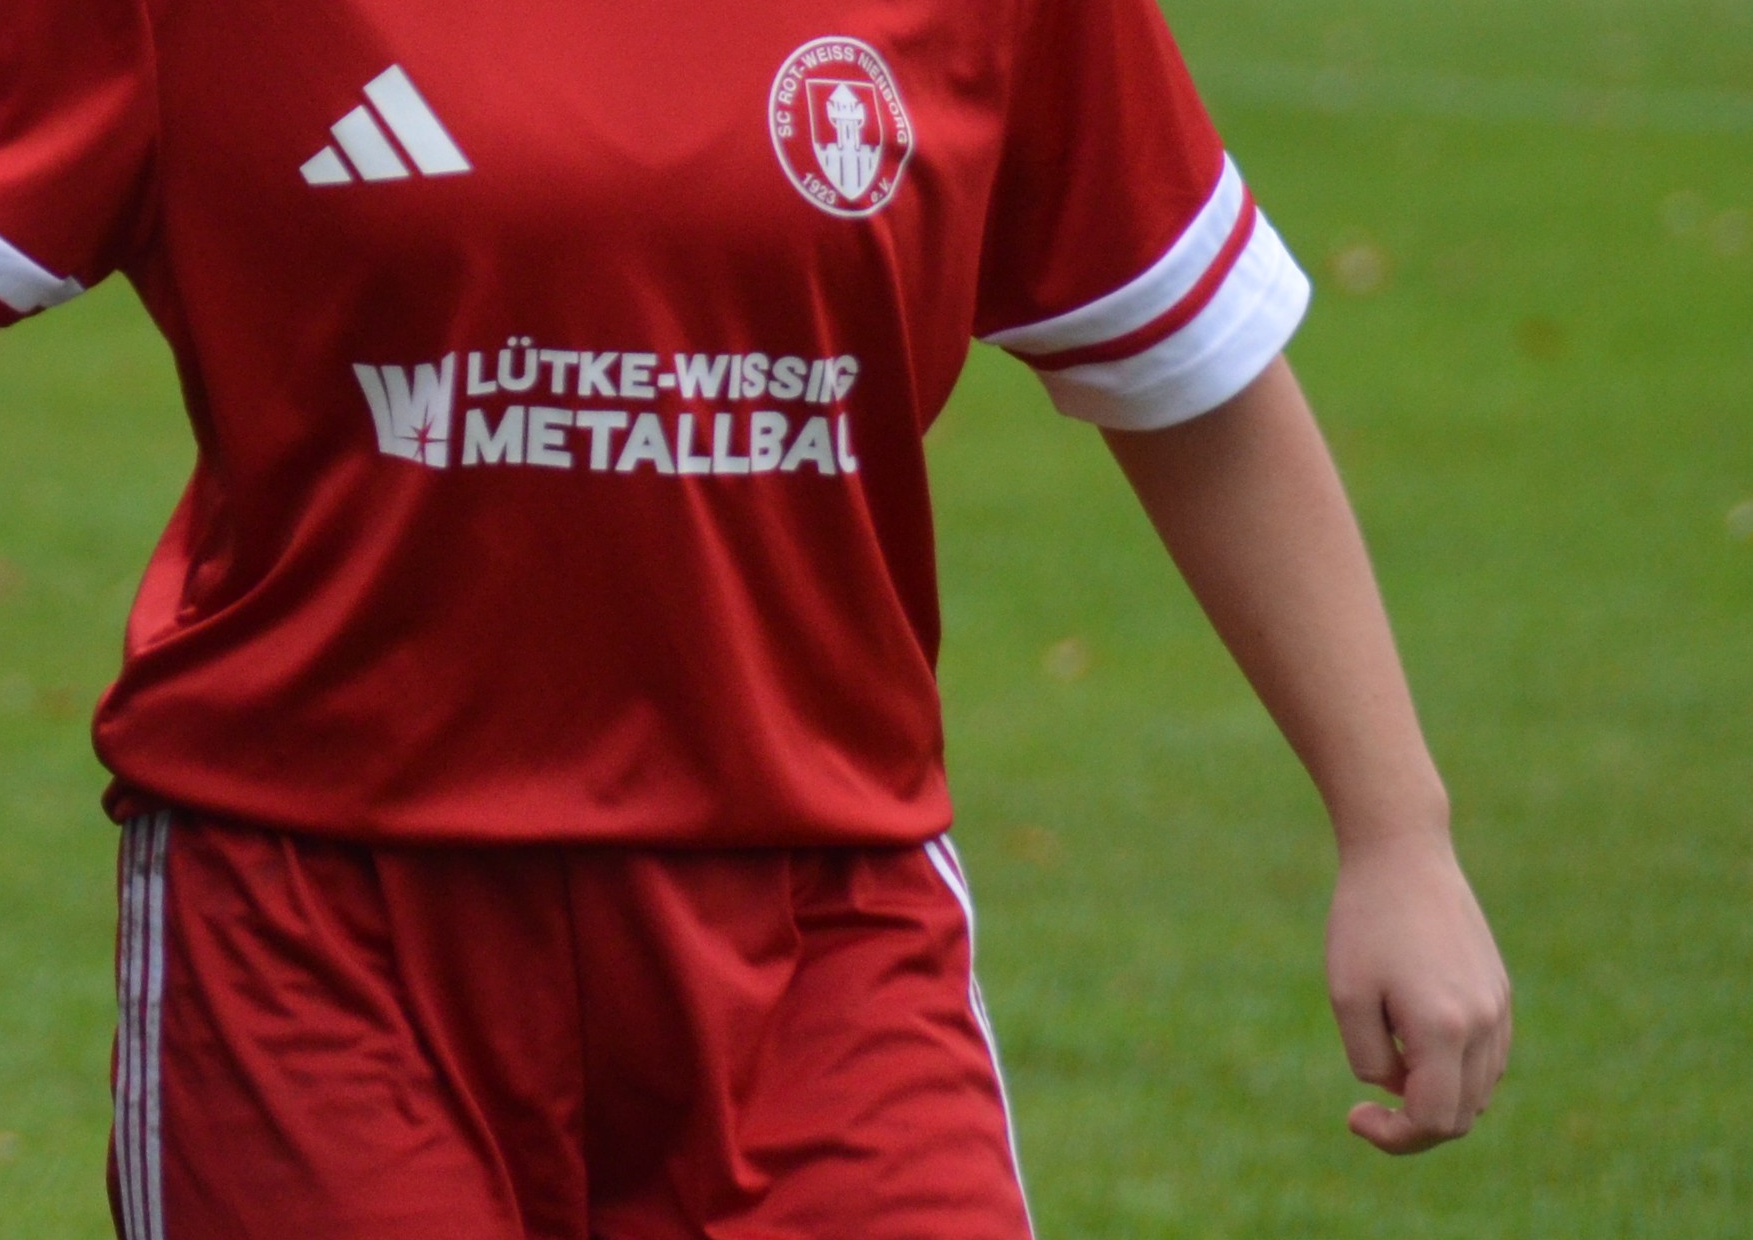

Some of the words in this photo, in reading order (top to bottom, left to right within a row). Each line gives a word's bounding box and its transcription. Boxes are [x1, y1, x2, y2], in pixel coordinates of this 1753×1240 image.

[778, 44, 855, 105] ROT-WEISS
[858, 51, 907, 144] NIENBORG
[777, 112, 793, 138] SC
[801, 172, 837, 205] 1923
